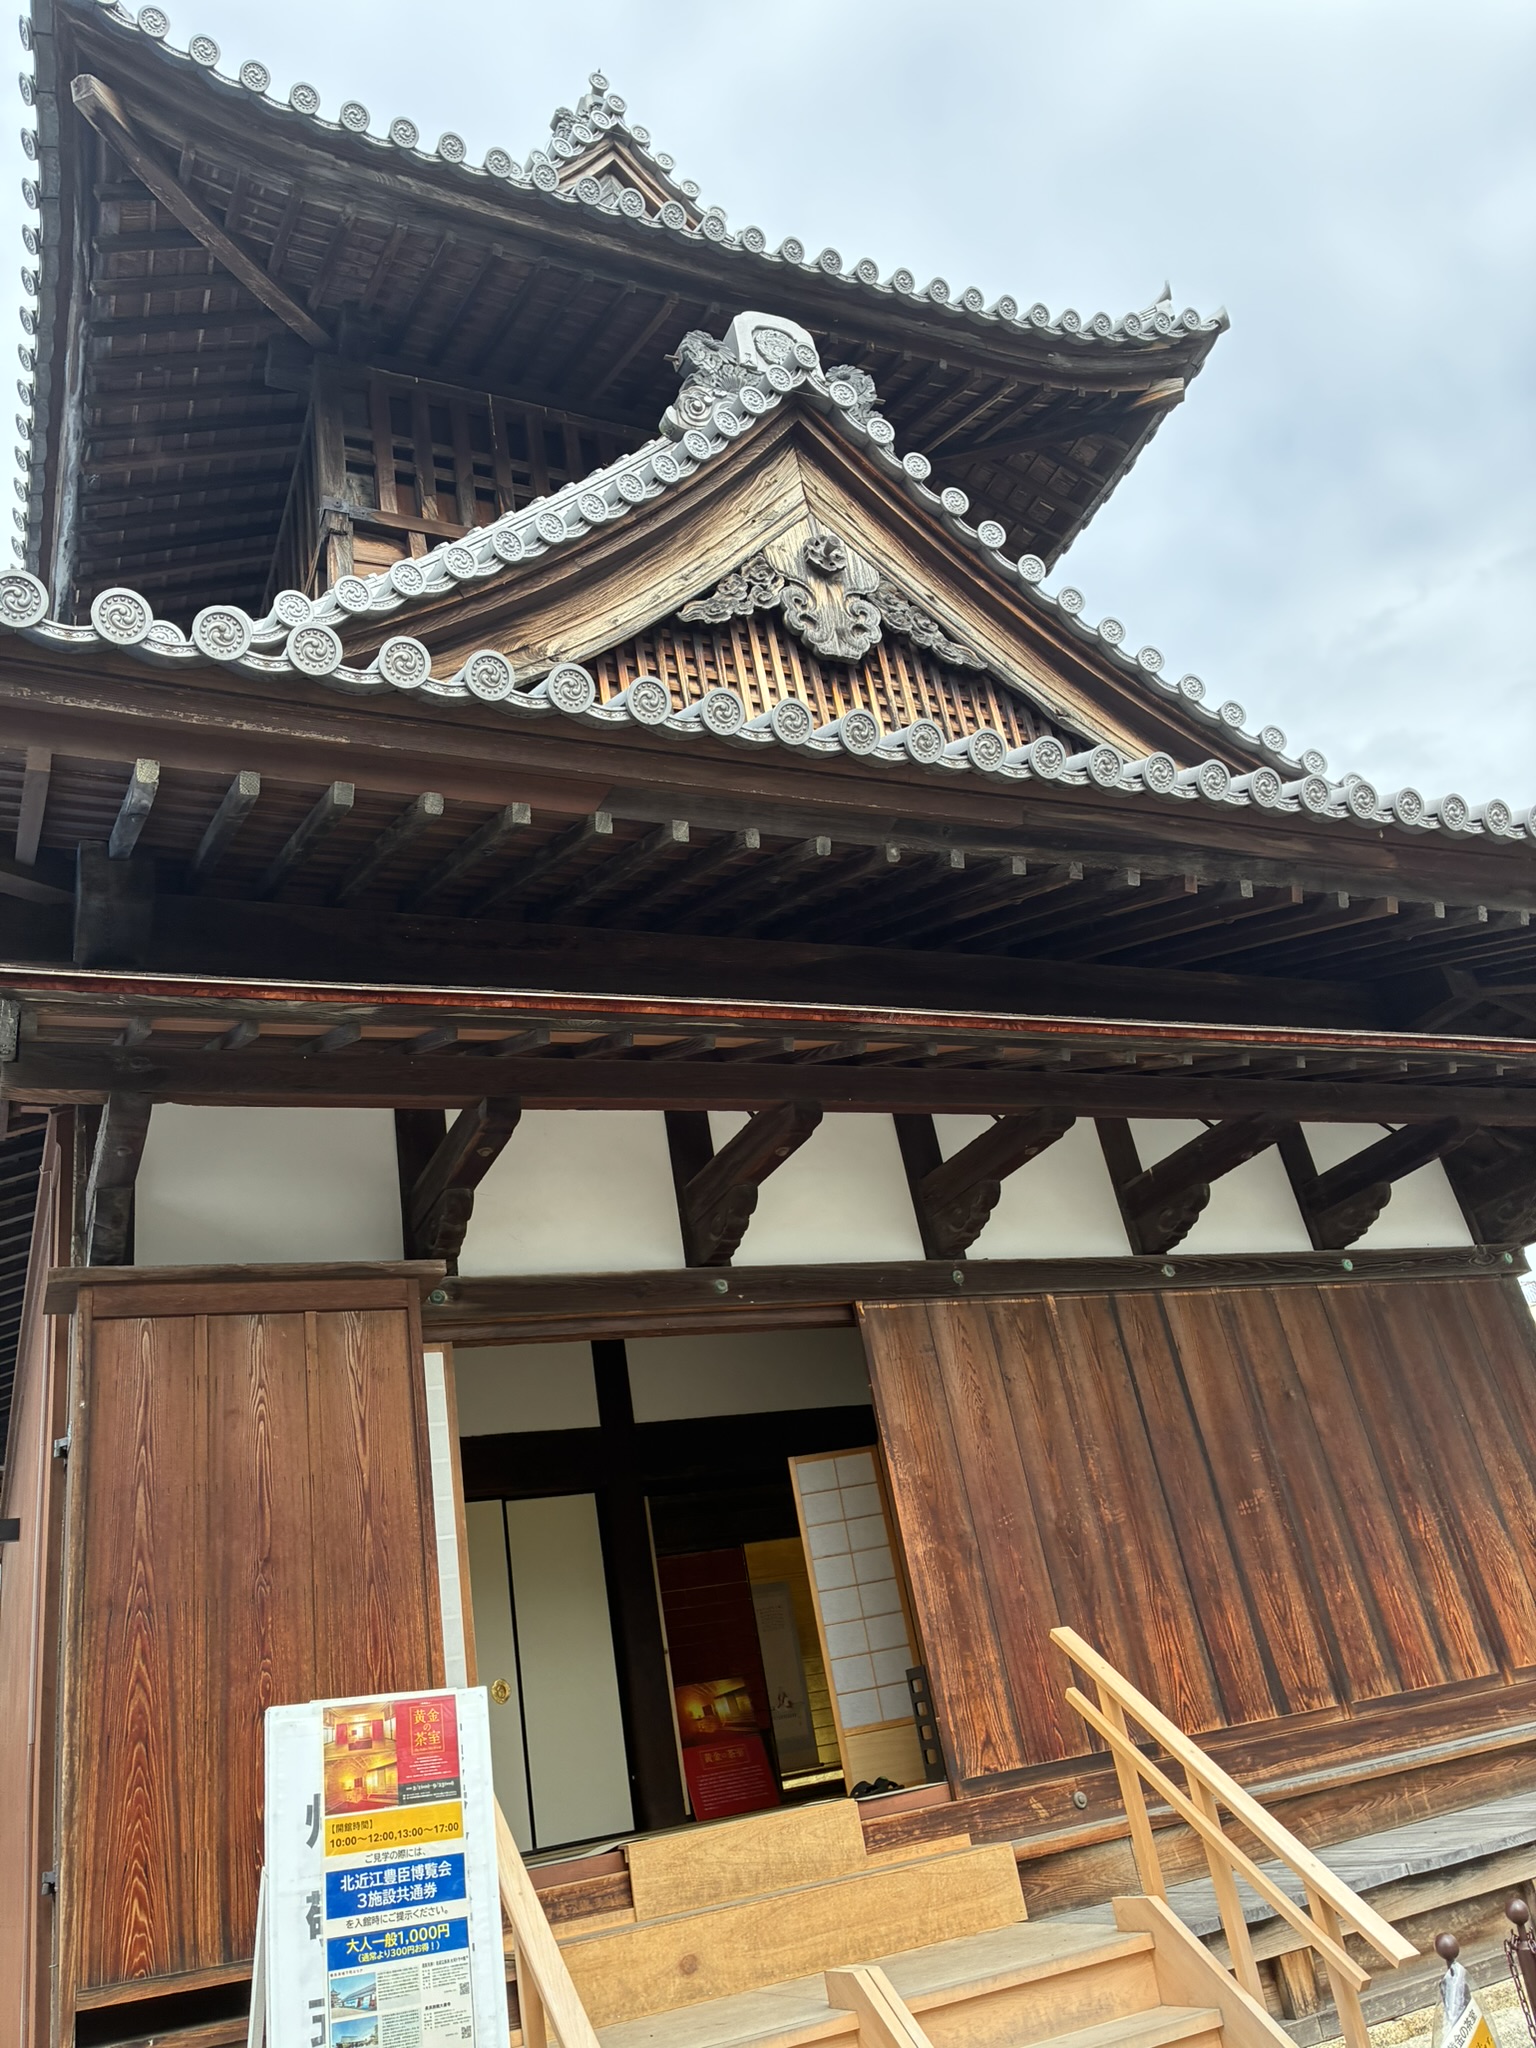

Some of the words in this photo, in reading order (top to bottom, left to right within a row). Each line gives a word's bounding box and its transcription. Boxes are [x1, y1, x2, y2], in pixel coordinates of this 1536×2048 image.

[413, 1708, 440, 1725] 黄金
[423, 1723, 431, 1731] の
[414, 1730, 441, 1747] 茶室
[365, 1848, 427, 1863] ご見学の際には、
[340, 1860, 452, 1892] 北近江豊臣博覧会
[357, 1882, 438, 1908] 3施設共通券
[346, 1906, 449, 1929] を入館時にご提示ください。
[346, 1923, 450, 1954] 大人一般1,000円
